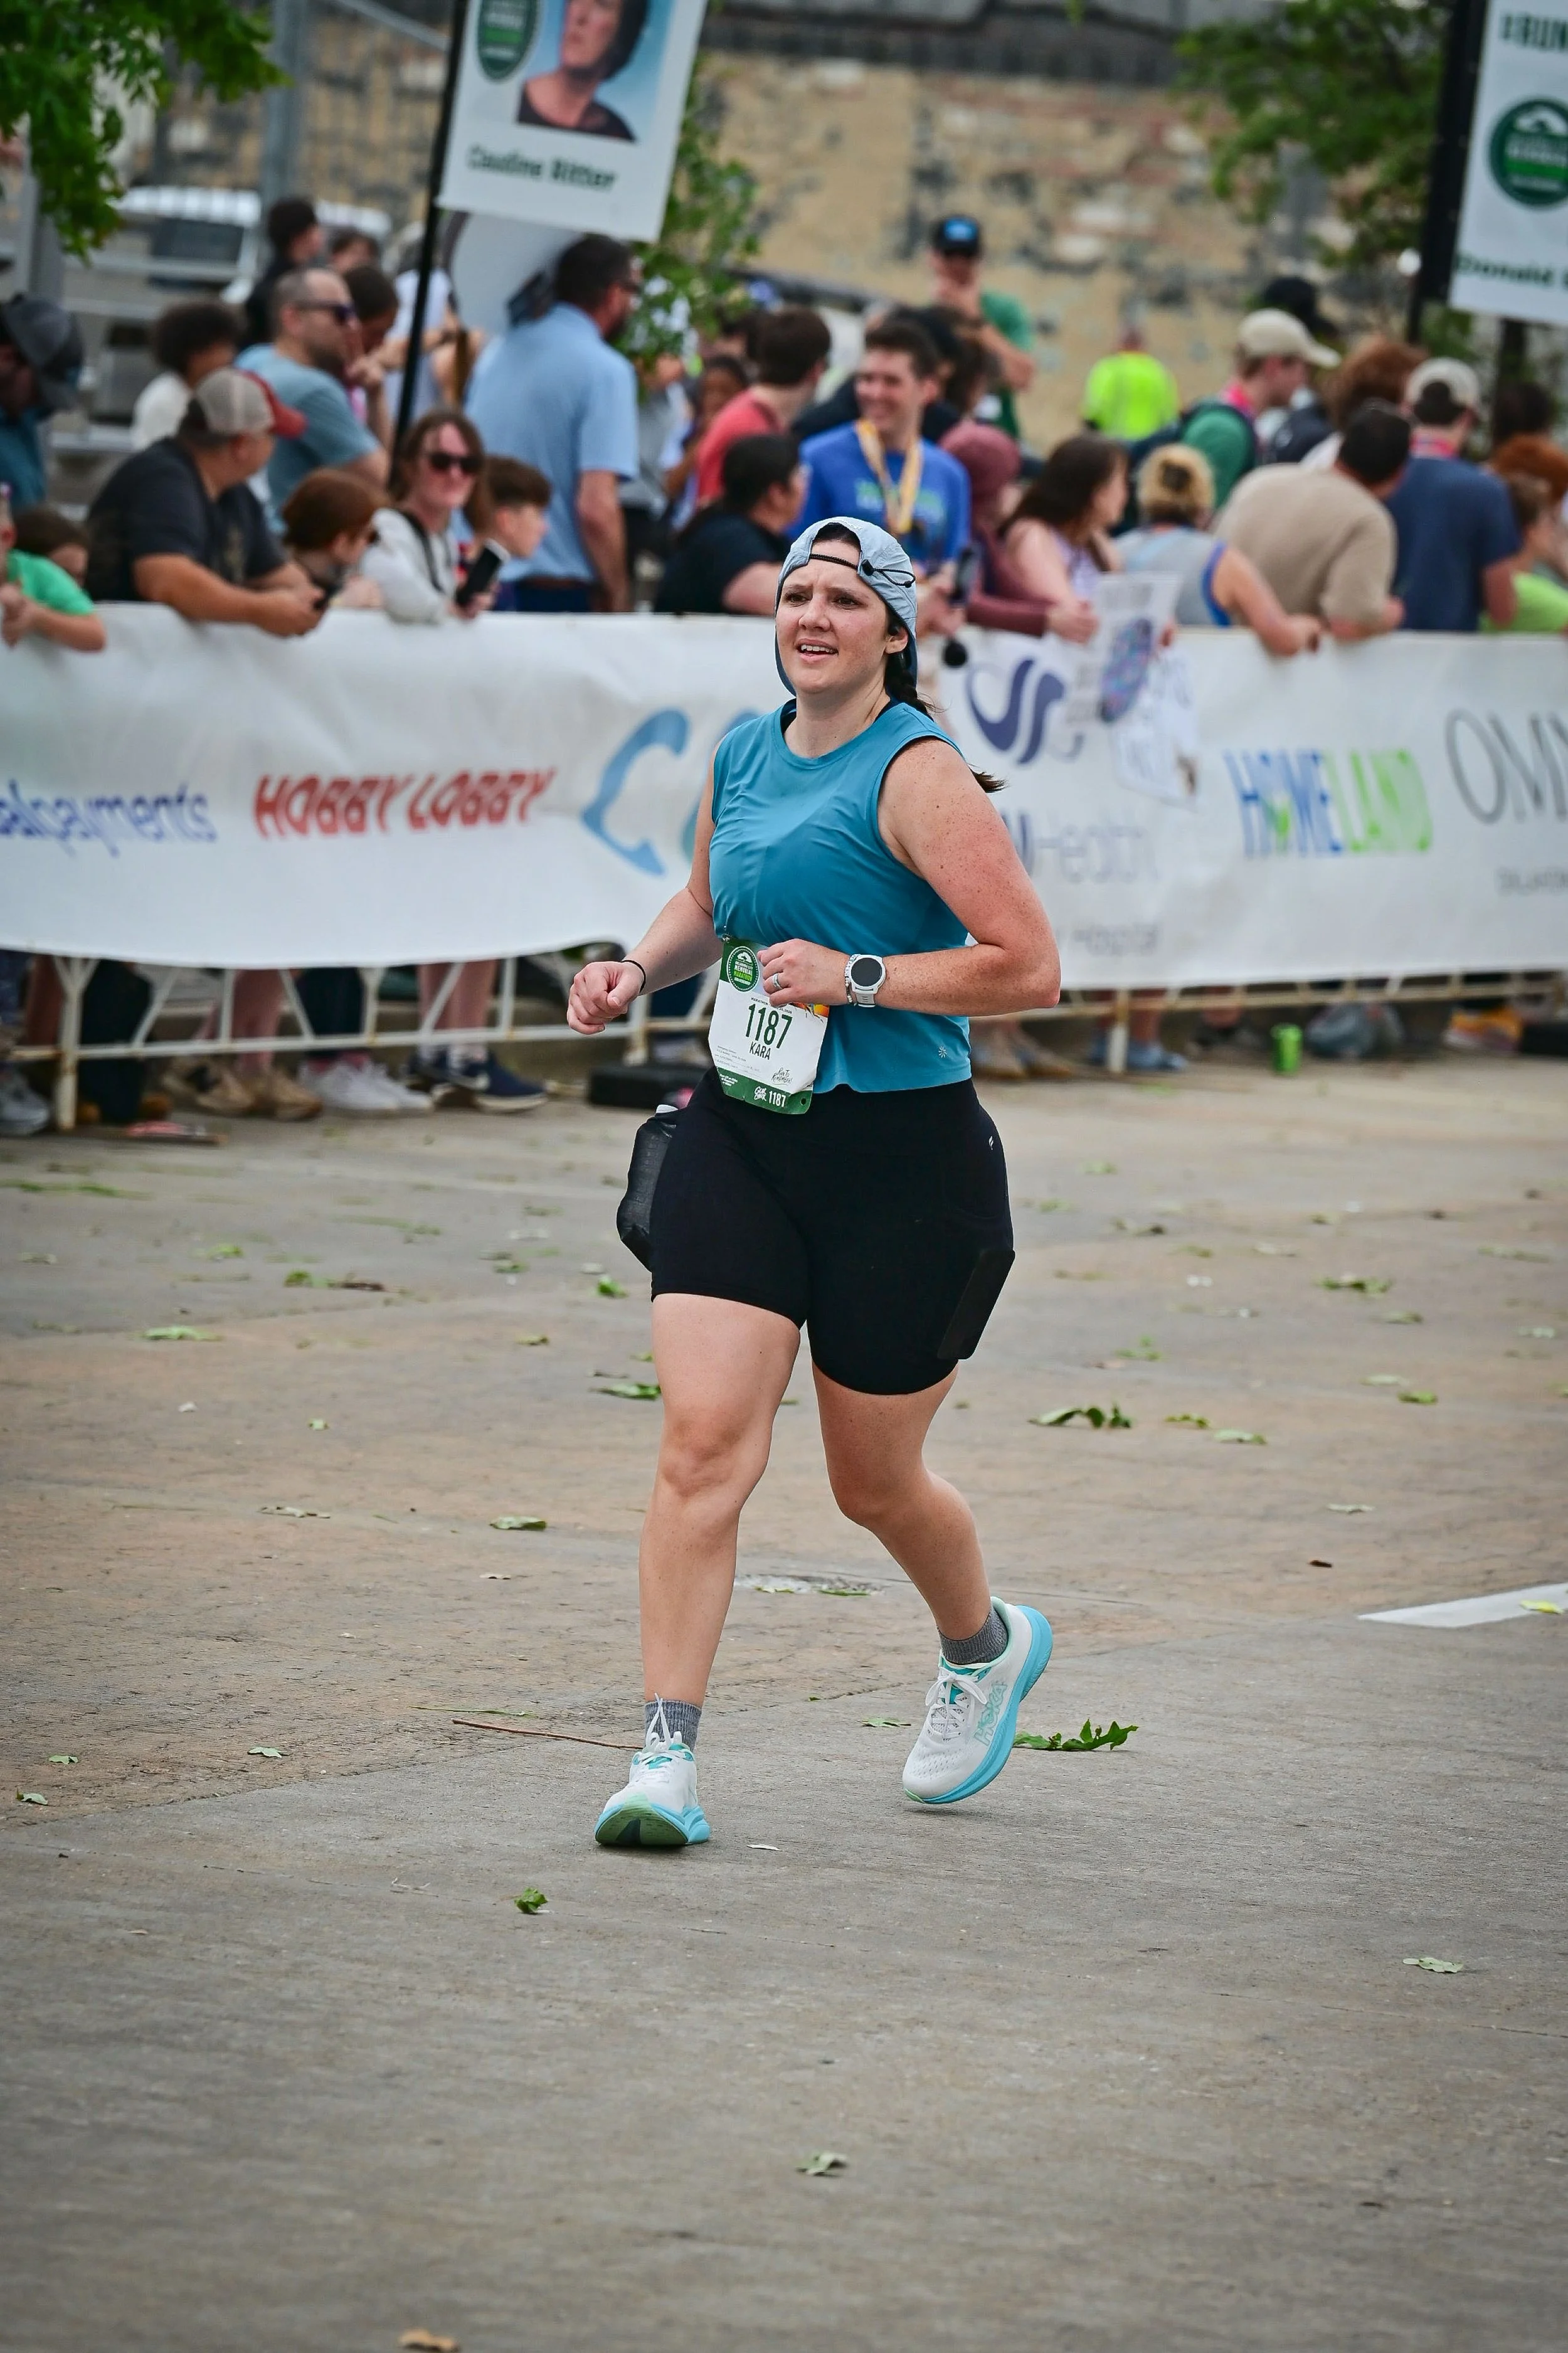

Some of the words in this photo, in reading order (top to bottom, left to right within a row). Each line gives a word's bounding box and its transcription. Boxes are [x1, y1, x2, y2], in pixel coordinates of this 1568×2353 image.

[253, 772, 414, 838] HOBBY
[406, 766, 557, 831] LOBBY
[1222, 748, 1434, 857] HOMELAND
[745, 1003, 793, 1049] 1187
[749, 1041, 771, 1060] KARA
[768, 1090, 787, 1108] 1187
[974, 1682, 1009, 1746] HOKA
